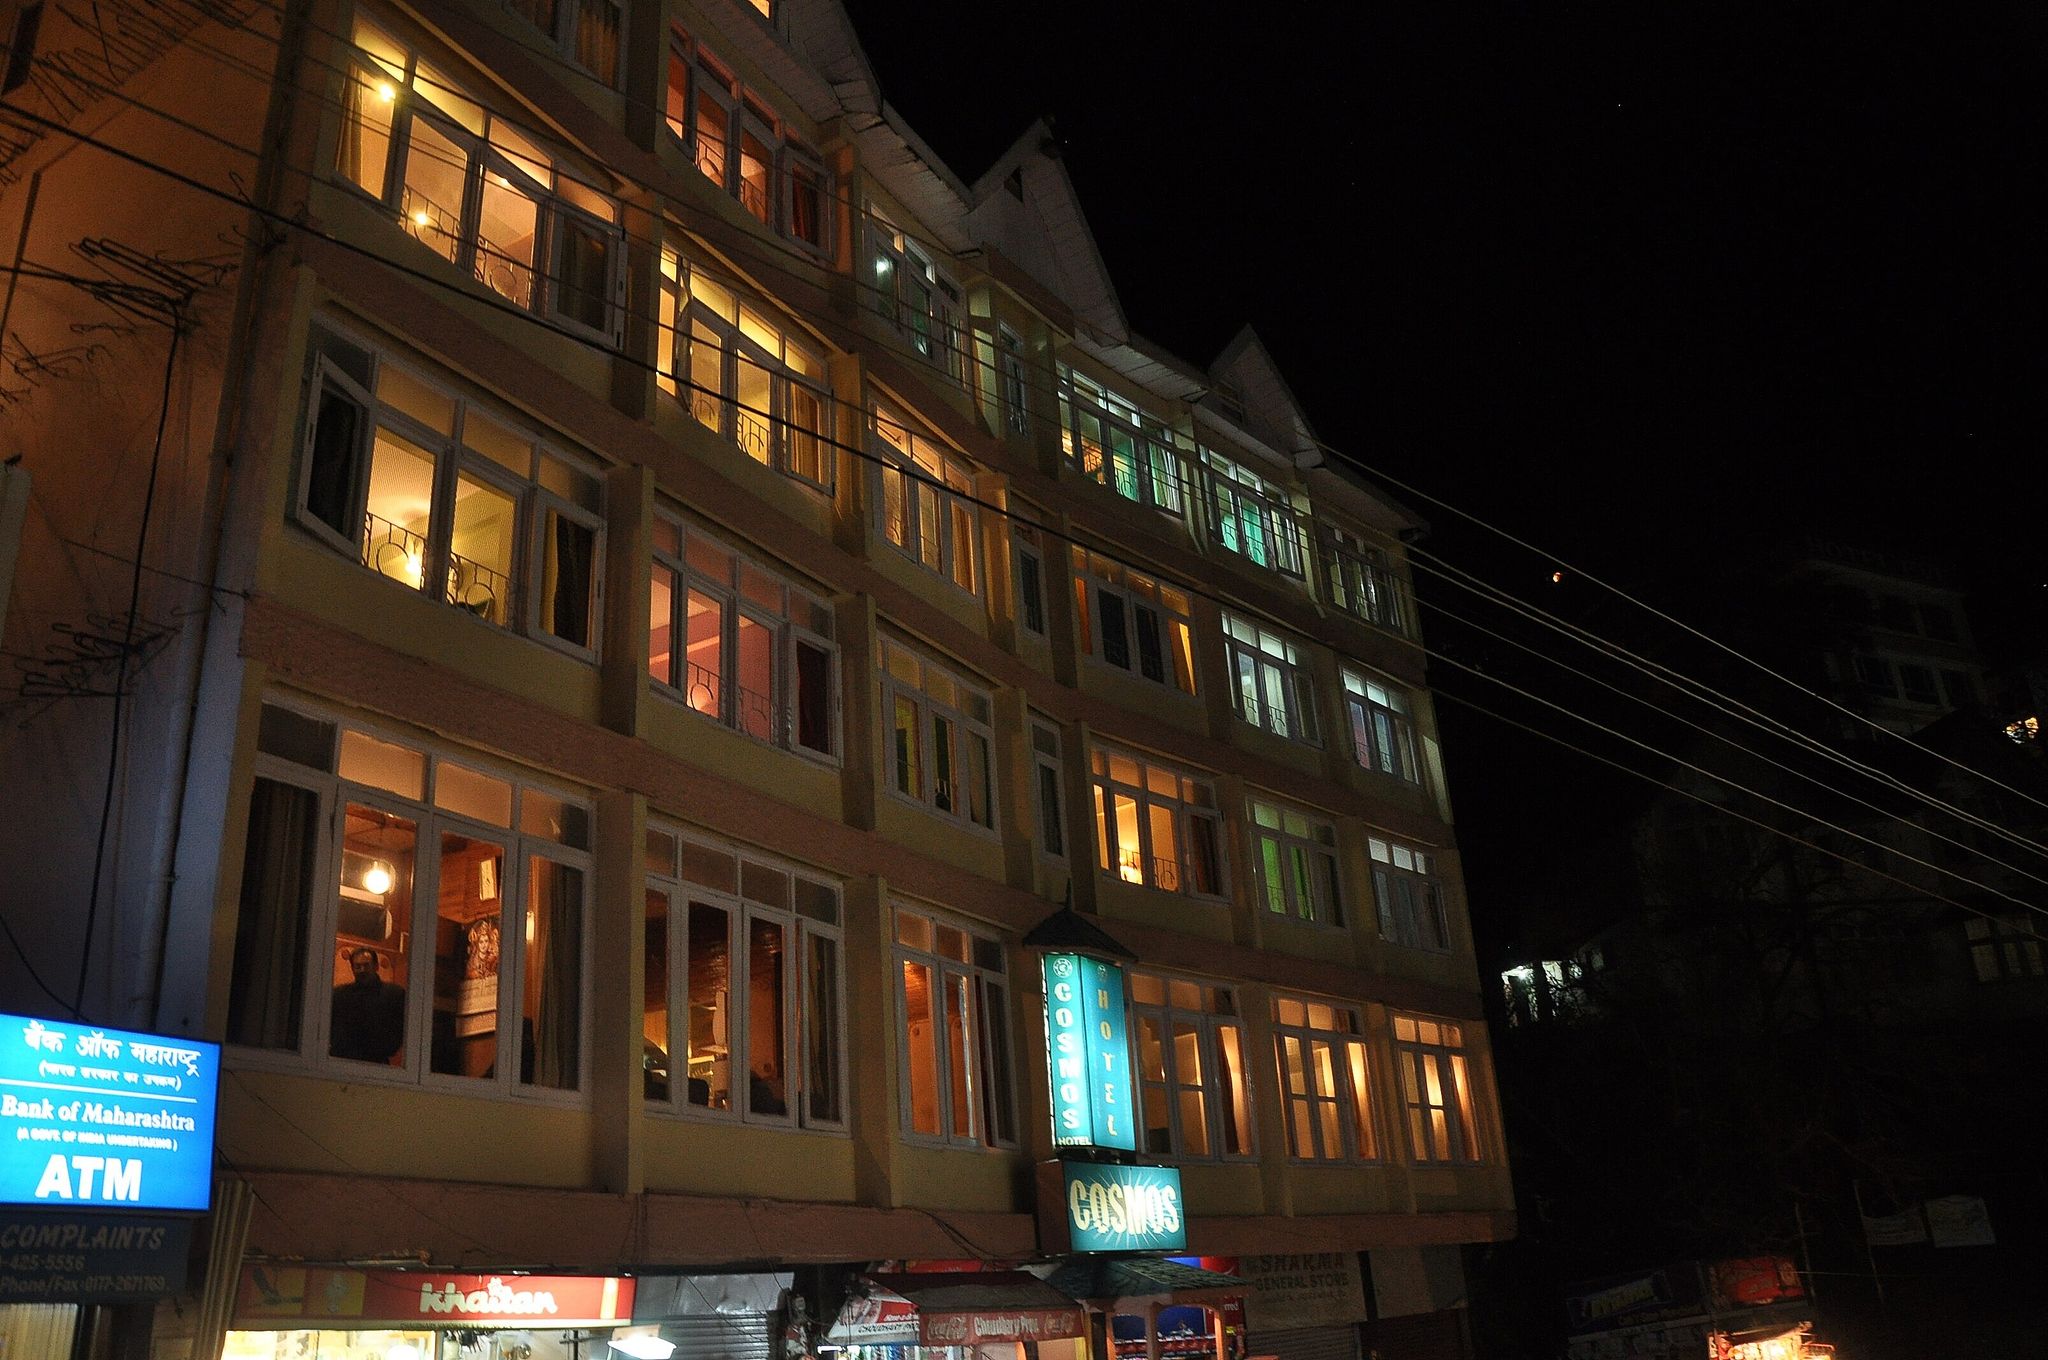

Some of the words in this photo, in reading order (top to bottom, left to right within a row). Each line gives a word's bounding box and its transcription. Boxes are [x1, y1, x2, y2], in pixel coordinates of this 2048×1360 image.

[23, 1019, 67, 1053] बैंक
[75, 1030, 122, 1060] ऑफ
[129, 1042, 202, 1078] महाराष्ट्र
[1054, 982, 1081, 1130] COSMOS
[1097, 989, 1118, 1137] HOTEL
[0, 1094, 55, 1121] Bank
[57, 1101, 81, 1122] of
[81, 1101, 196, 1132] Maharashtra
[62, 1130, 78, 1143] OF
[1058, 1135, 1093, 1147] HOTEL
[34, 1153, 143, 1202] ATM
[1069, 1178, 1181, 1236] COSMOS
[0, 1223, 166, 1250] COMPLAINTS
[1256, 1276, 1309, 1291] GENERAL
[1310, 1272, 1349, 1288] STORE
[1260, 1252, 1345, 1273] SHARMA
[419, 1276, 559, 1314] khaitan
